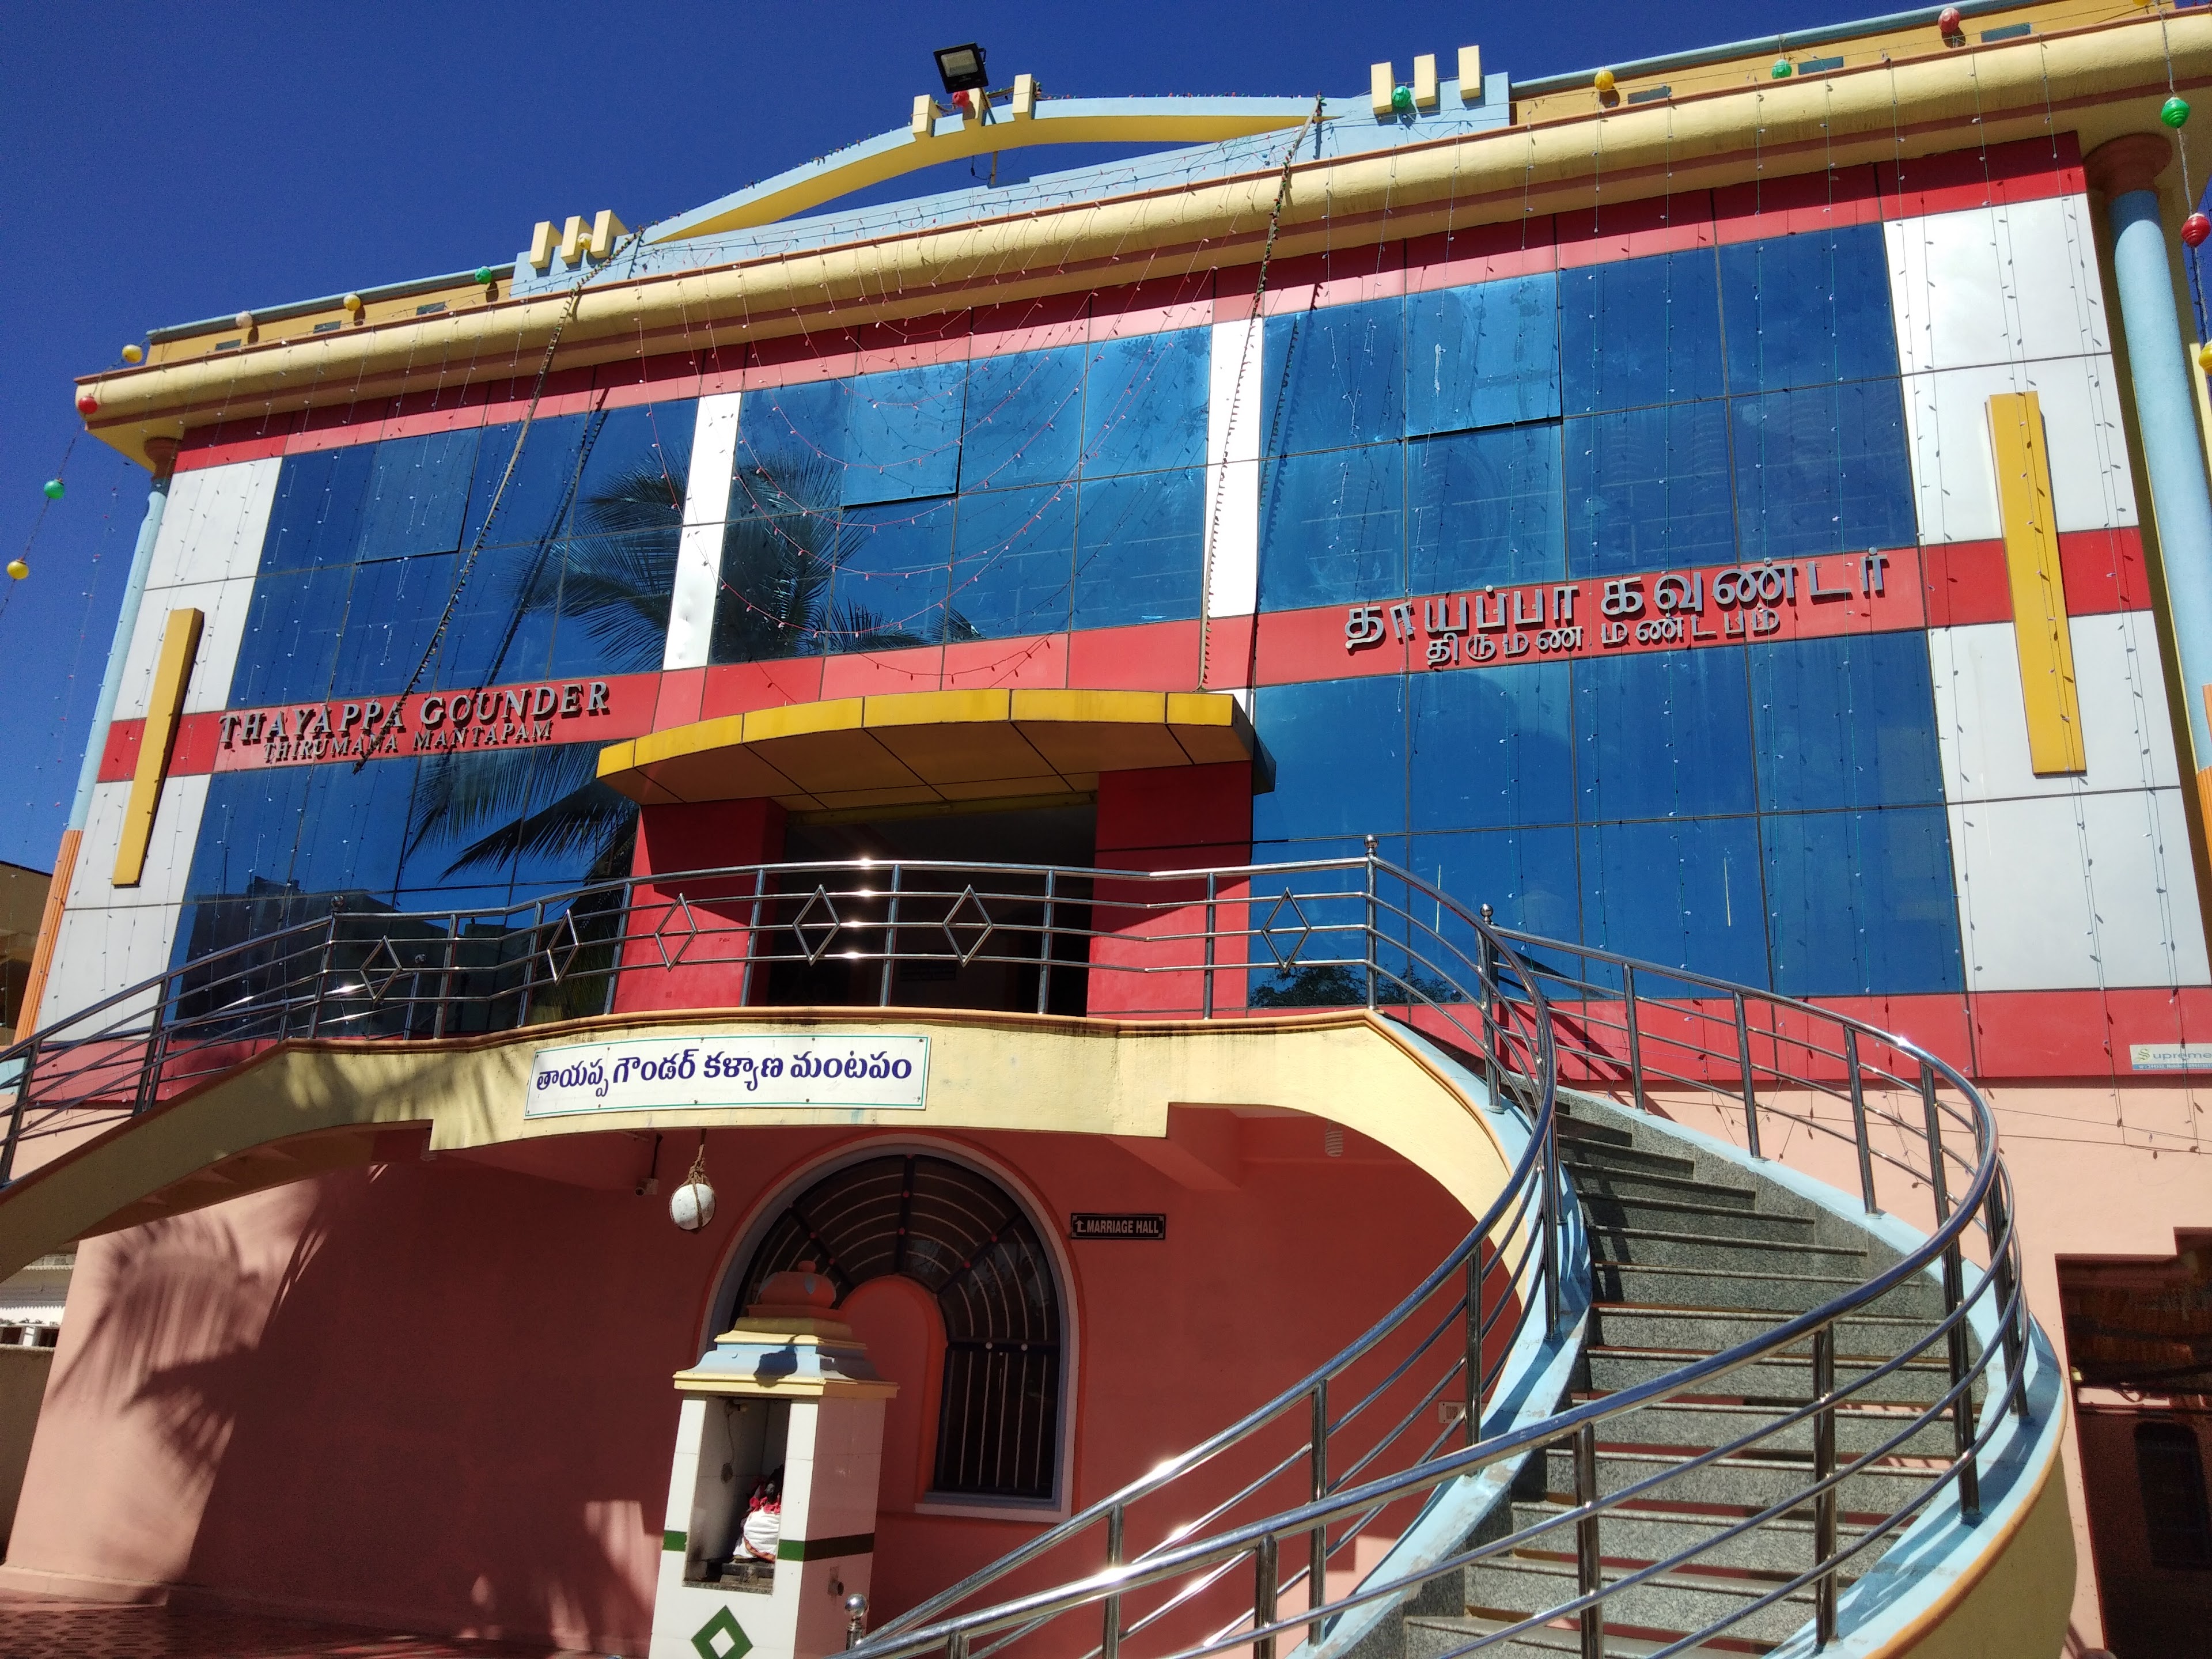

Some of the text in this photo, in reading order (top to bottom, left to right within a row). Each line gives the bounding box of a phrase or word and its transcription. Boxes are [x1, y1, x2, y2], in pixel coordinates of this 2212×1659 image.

[1345, 585, 1579, 649] தாயப்பா
[1426, 603, 1780, 666] திருமண மண்டபம்
[218, 681, 609, 744] THAYAPPA GOUNDER
[263, 719, 553, 762] THIRUMANA MANTAPAM
[536, 1048, 912, 1097] తాయప్ప గౌండర్ కళ్యాణ మంటపం
[1086, 1219, 1159, 1234] MARRIAGE HALL
